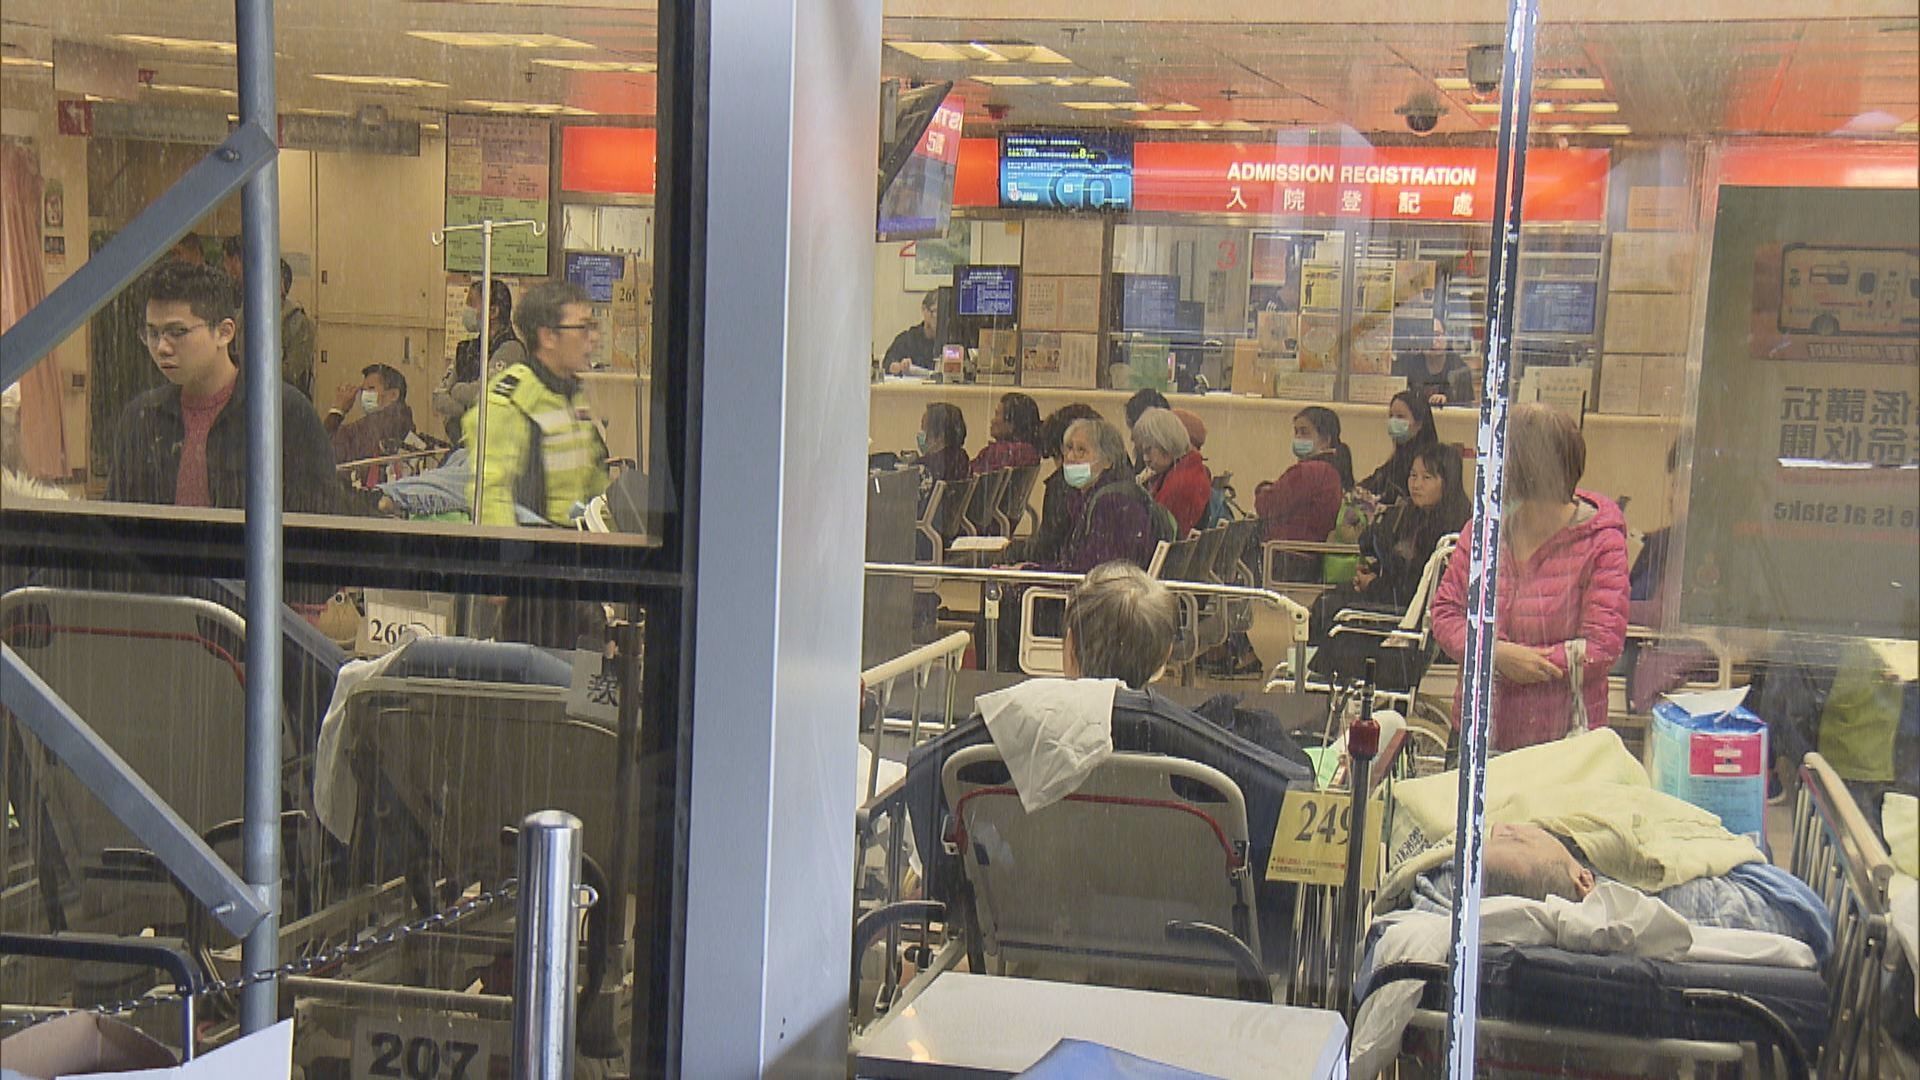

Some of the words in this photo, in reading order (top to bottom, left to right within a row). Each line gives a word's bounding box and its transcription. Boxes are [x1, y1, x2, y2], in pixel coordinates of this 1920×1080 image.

[1226, 163, 1334, 183] ADMISSION
[1340, 165, 1476, 186] REGISTRATION
[1226, 186, 1473, 216] 入院登記處
[1216, 240, 1237, 270] 3
[368, 1031, 479, 1080] 207
